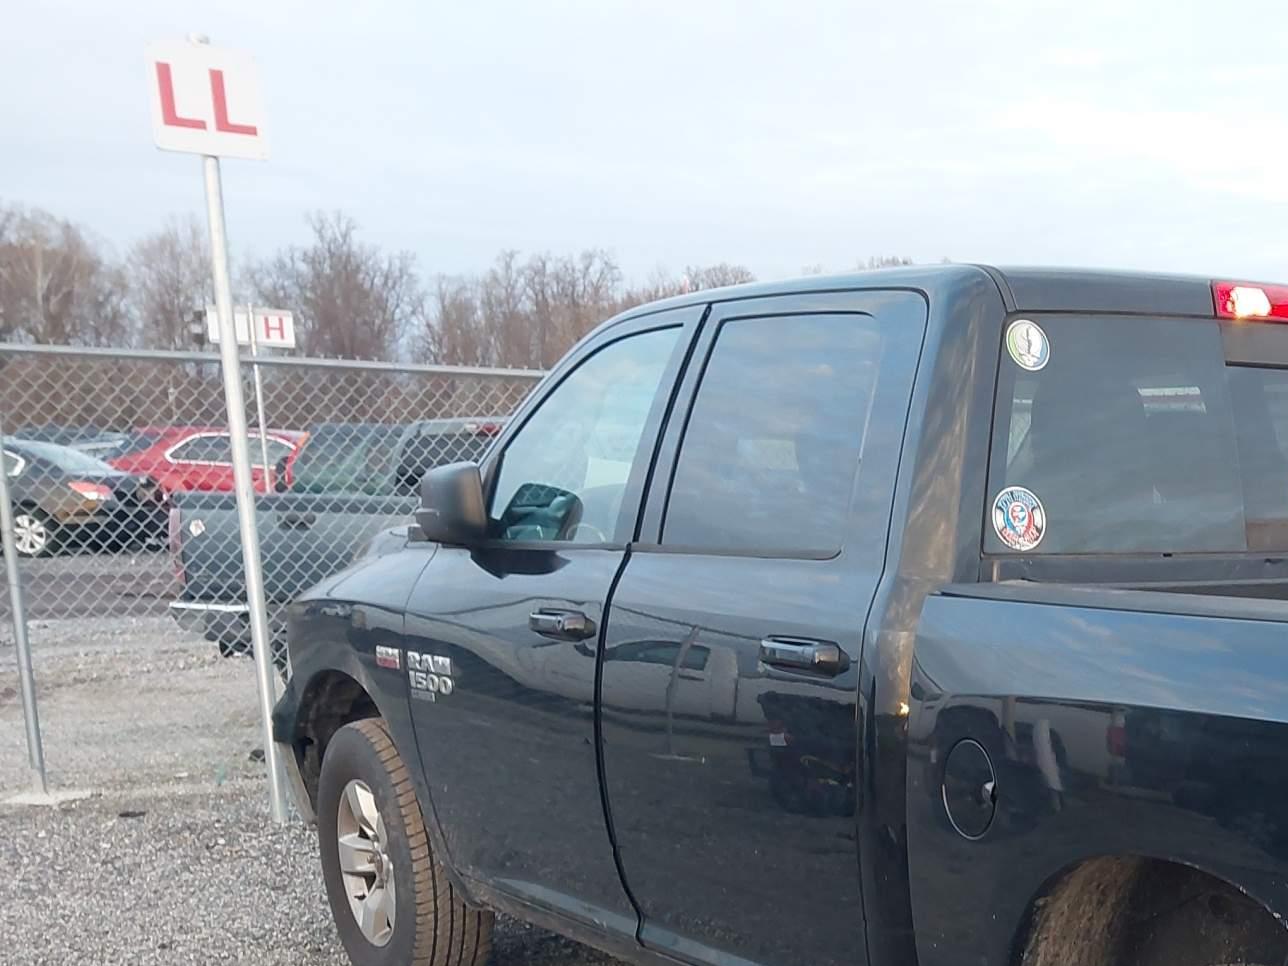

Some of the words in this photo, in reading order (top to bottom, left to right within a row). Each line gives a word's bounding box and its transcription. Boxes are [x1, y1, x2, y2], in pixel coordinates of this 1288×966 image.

[155, 61, 258, 136] LL
[264, 315, 285, 340] H
[407, 650, 452, 676] RAM
[408, 669, 454, 696] 1500
